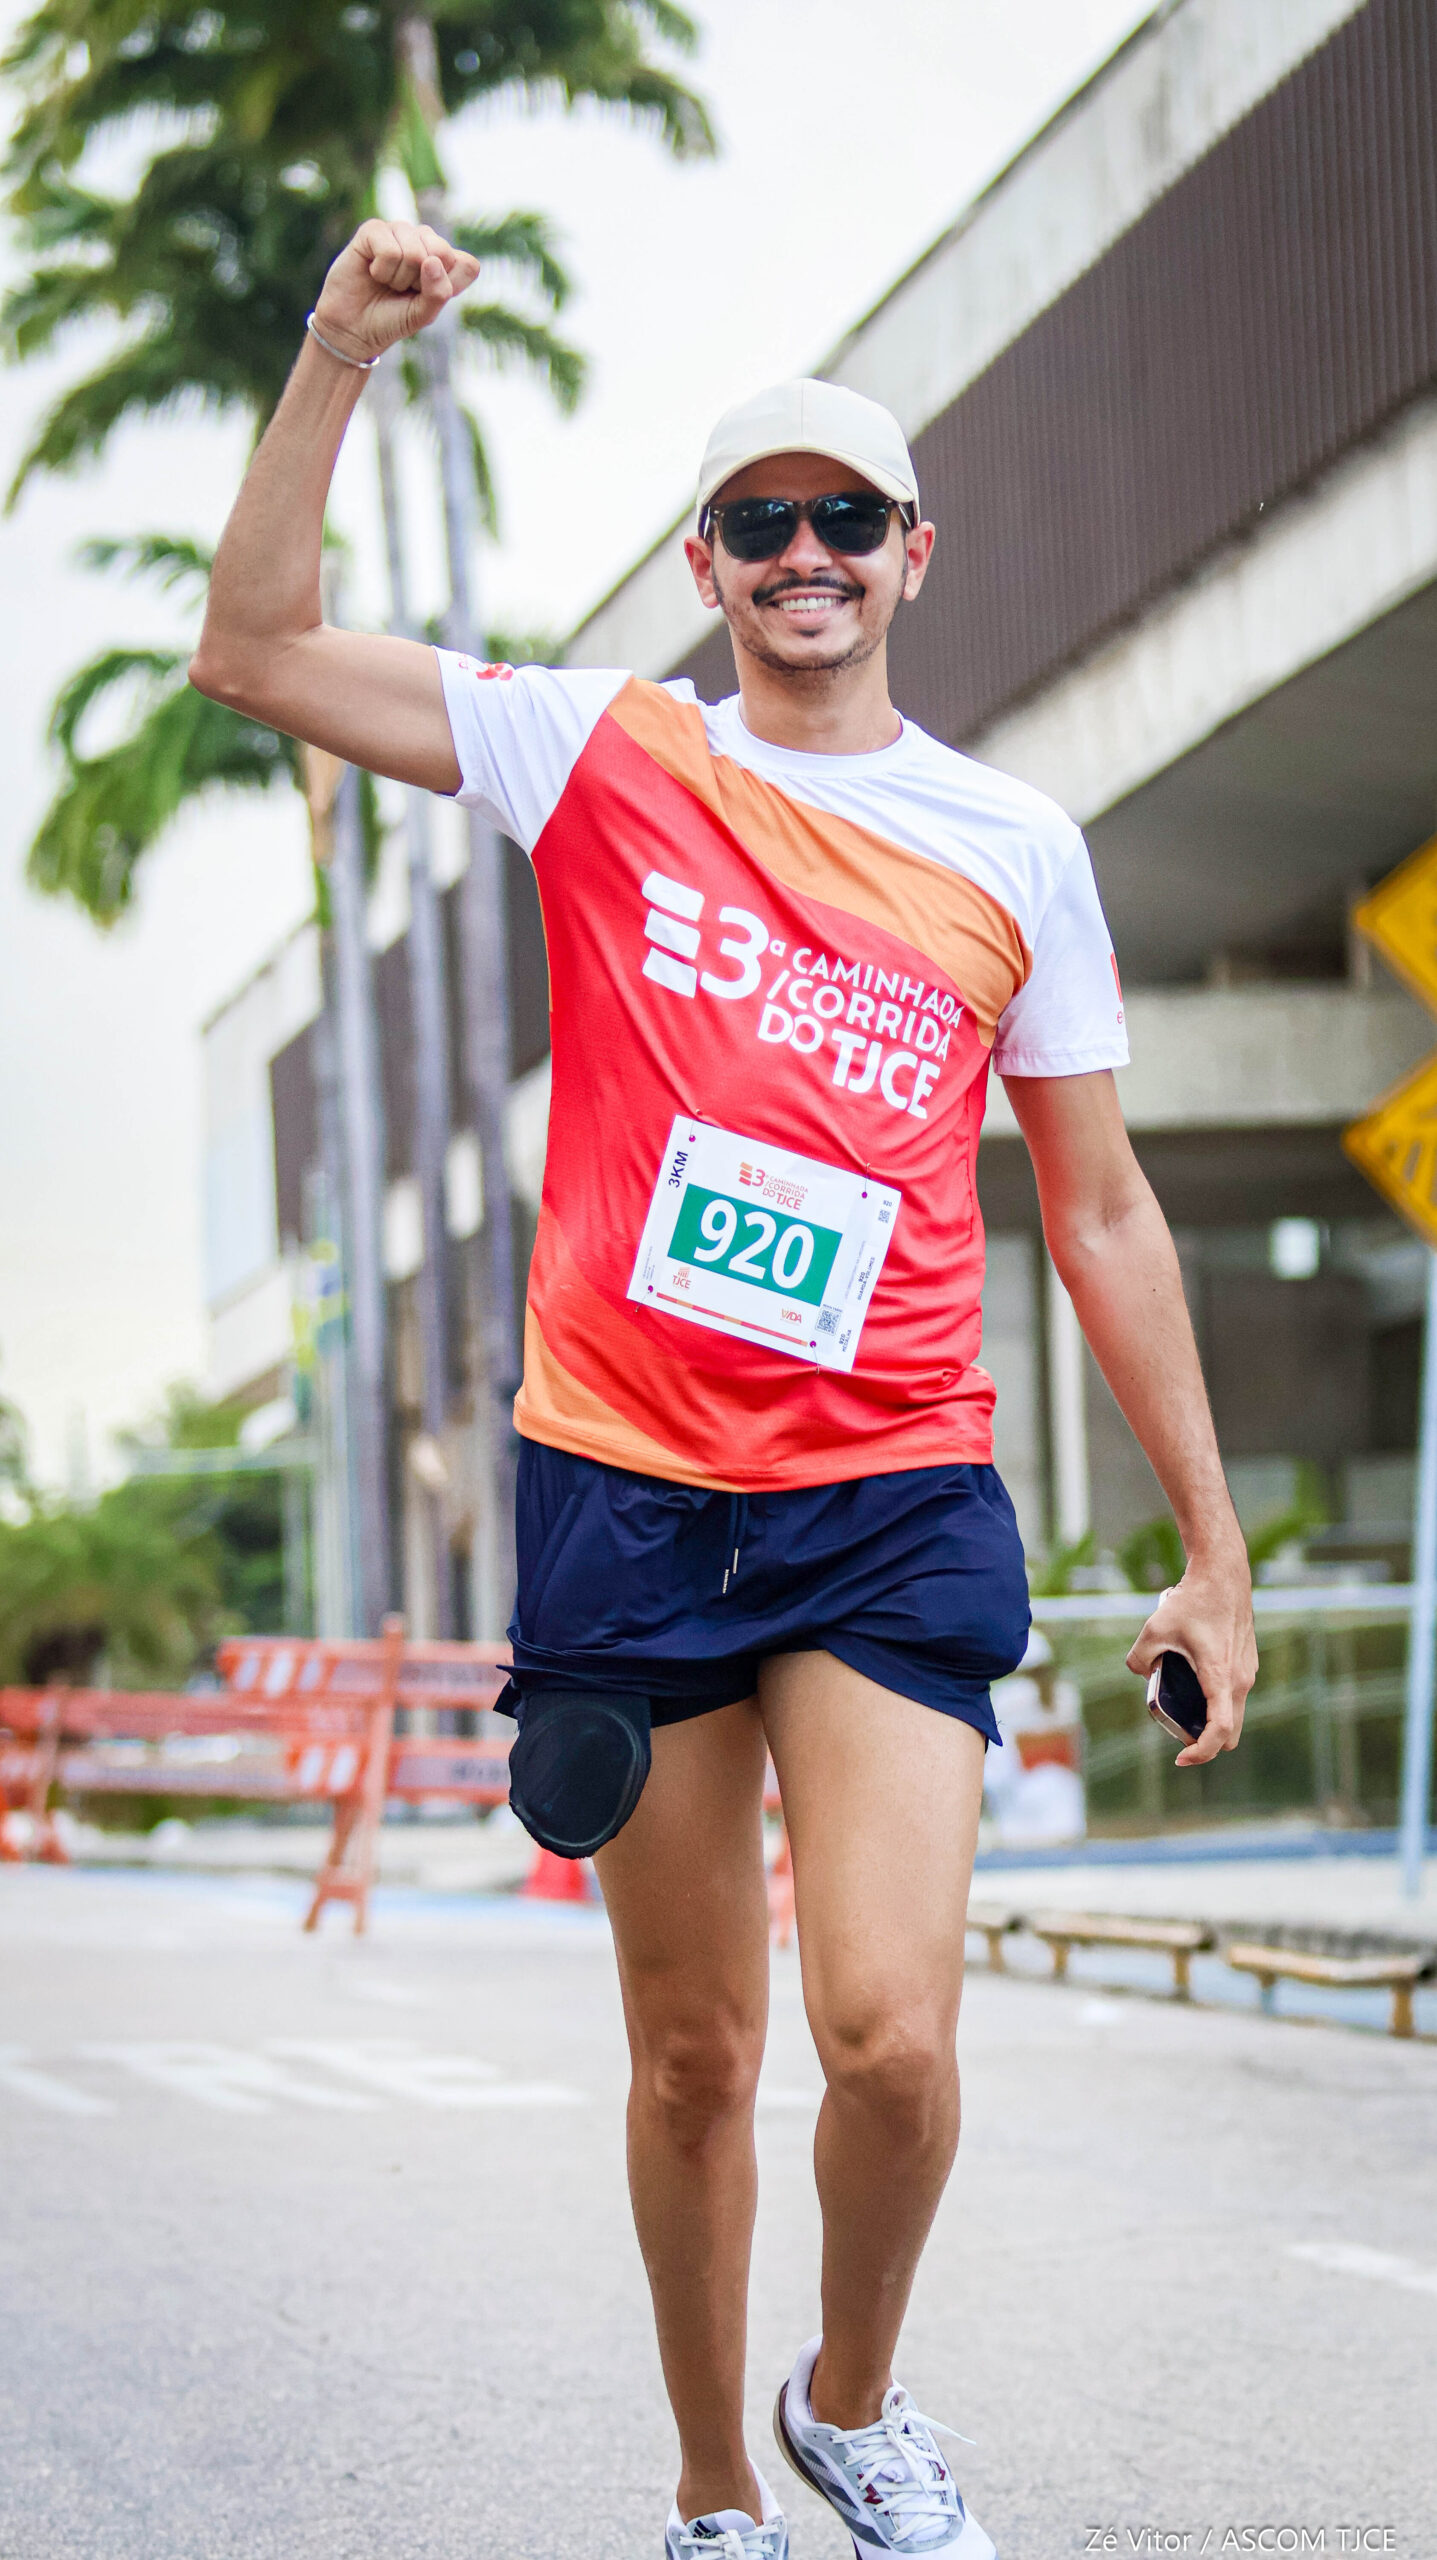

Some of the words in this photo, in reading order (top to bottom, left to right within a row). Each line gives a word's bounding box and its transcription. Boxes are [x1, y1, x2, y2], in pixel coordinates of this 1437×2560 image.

[792, 948, 965, 1029] CAMINHADA
[757, 1002, 824, 1053] DO
[832, 1028, 941, 1120] TJCE
[668, 1150, 689, 1188] 3KM
[769, 1175, 809, 1194] CAMINHADA
[762, 1187, 776, 1198] DO
[776, 1192, 803, 1211] TJCE
[693, 1198, 815, 1289] 920
[672, 1274, 692, 1290] TJCE
